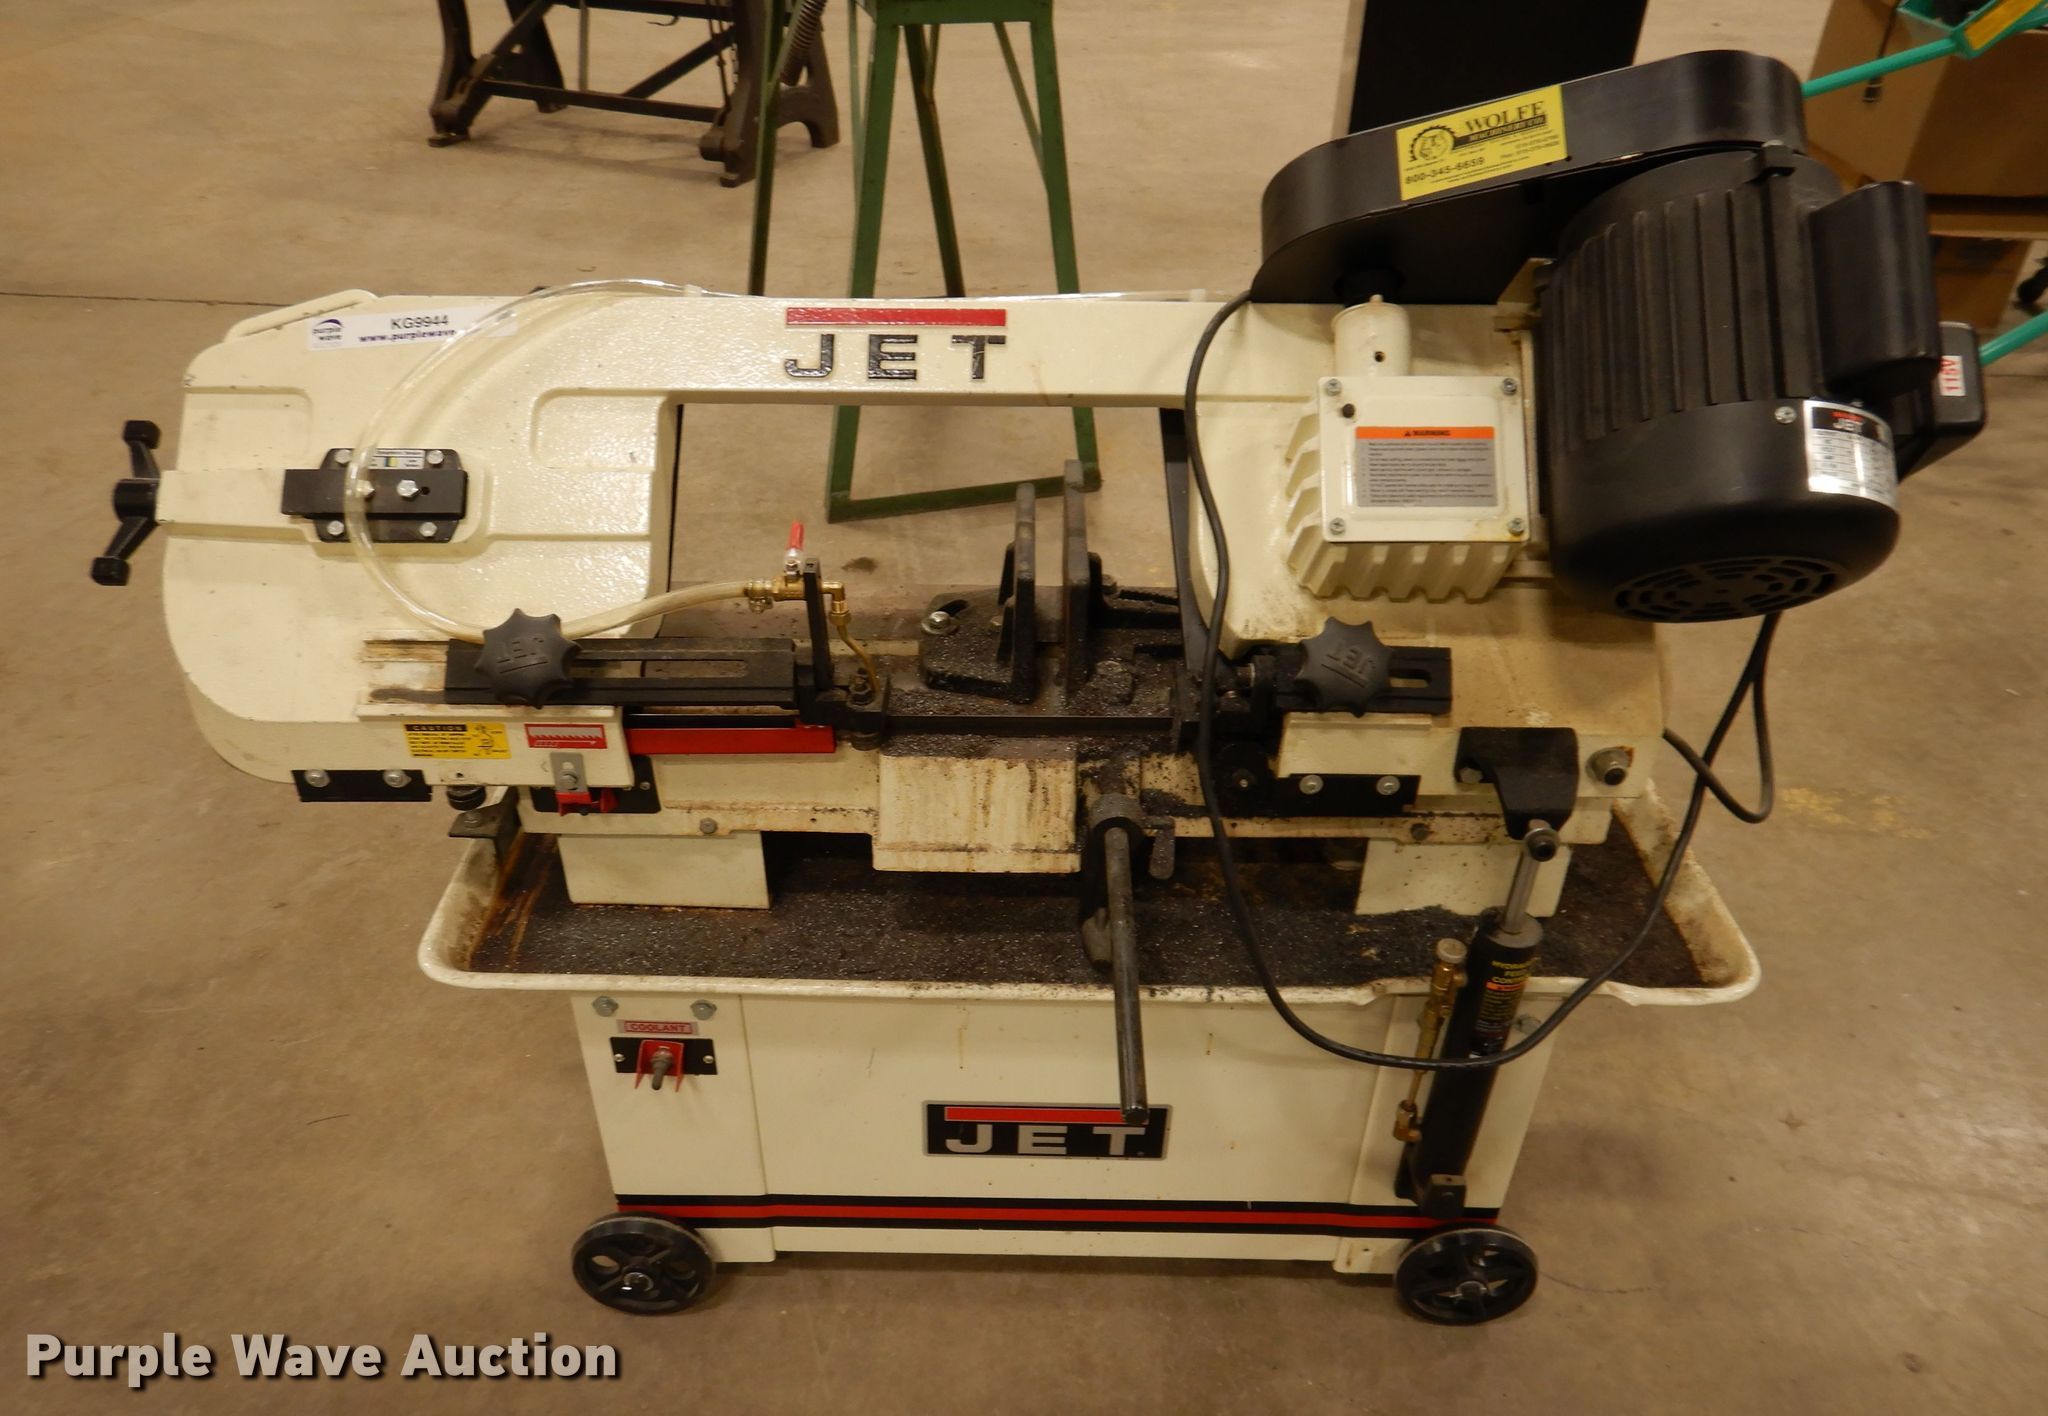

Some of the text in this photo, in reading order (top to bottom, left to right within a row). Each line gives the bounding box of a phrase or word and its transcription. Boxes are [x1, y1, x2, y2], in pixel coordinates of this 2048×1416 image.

[1465, 101, 1545, 132] WOLFE
[390, 315, 449, 330] KG9944
[312, 327, 342, 335] purple
[318, 334, 342, 342] wave
[784, 333, 1007, 380] JET
[630, 1023, 686, 1033] COOLANT
[944, 1123, 1146, 1156] JET
